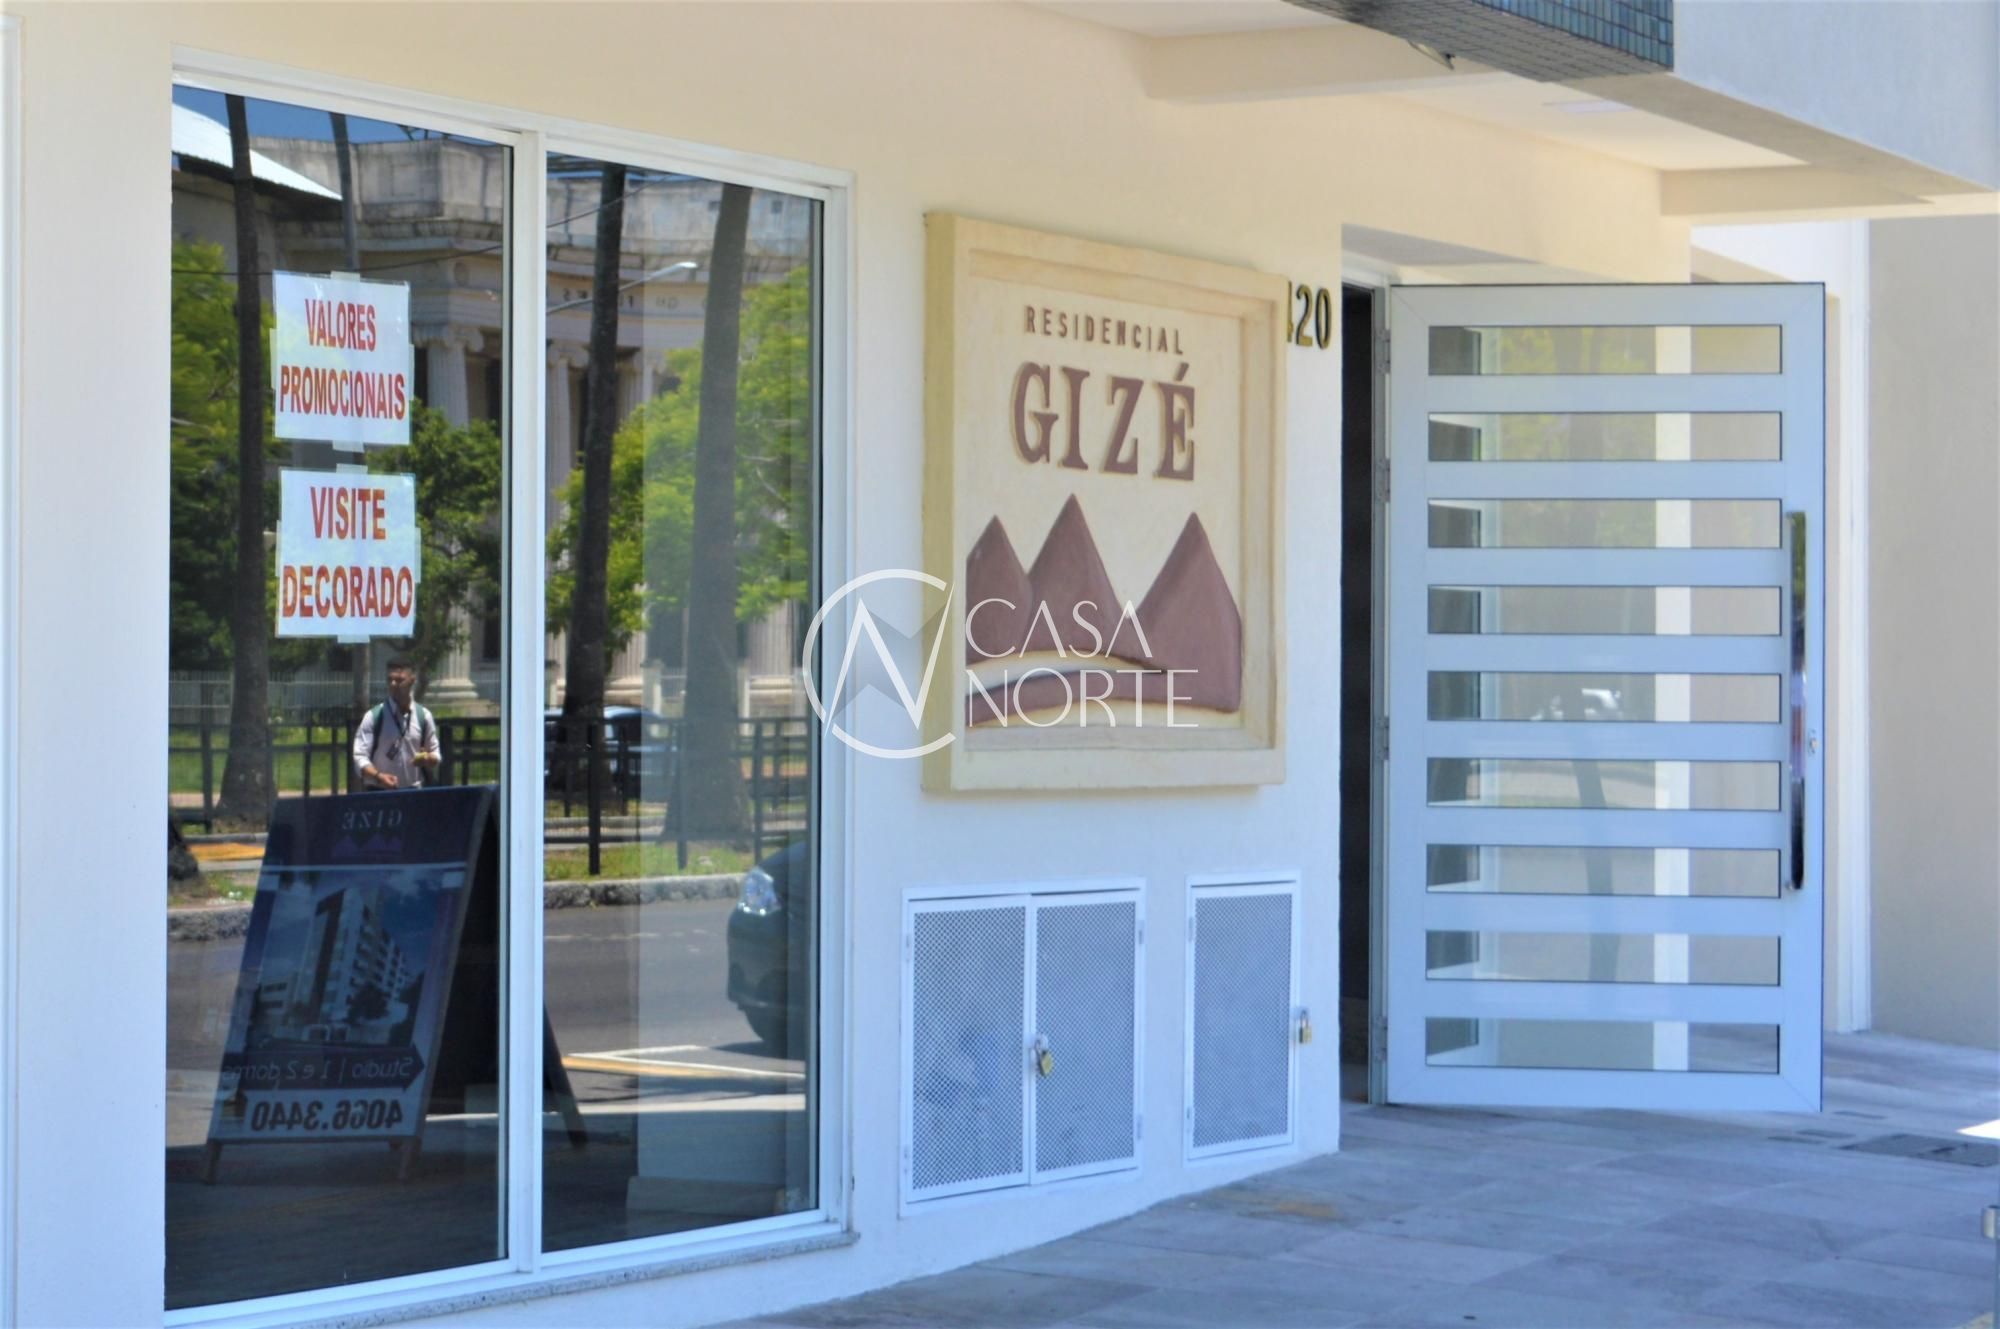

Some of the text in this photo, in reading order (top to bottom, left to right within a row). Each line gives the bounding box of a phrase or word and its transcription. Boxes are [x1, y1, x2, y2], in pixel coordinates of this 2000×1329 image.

[305, 299, 376, 351] VALORES
[1024, 305, 1184, 355] RESIDENCIAL
[280, 365, 405, 420] PROMOCIONAIS
[1011, 361, 1195, 481] GIZÉ
[310, 486, 386, 540] VISITE
[282, 565, 413, 618] DECORADO
